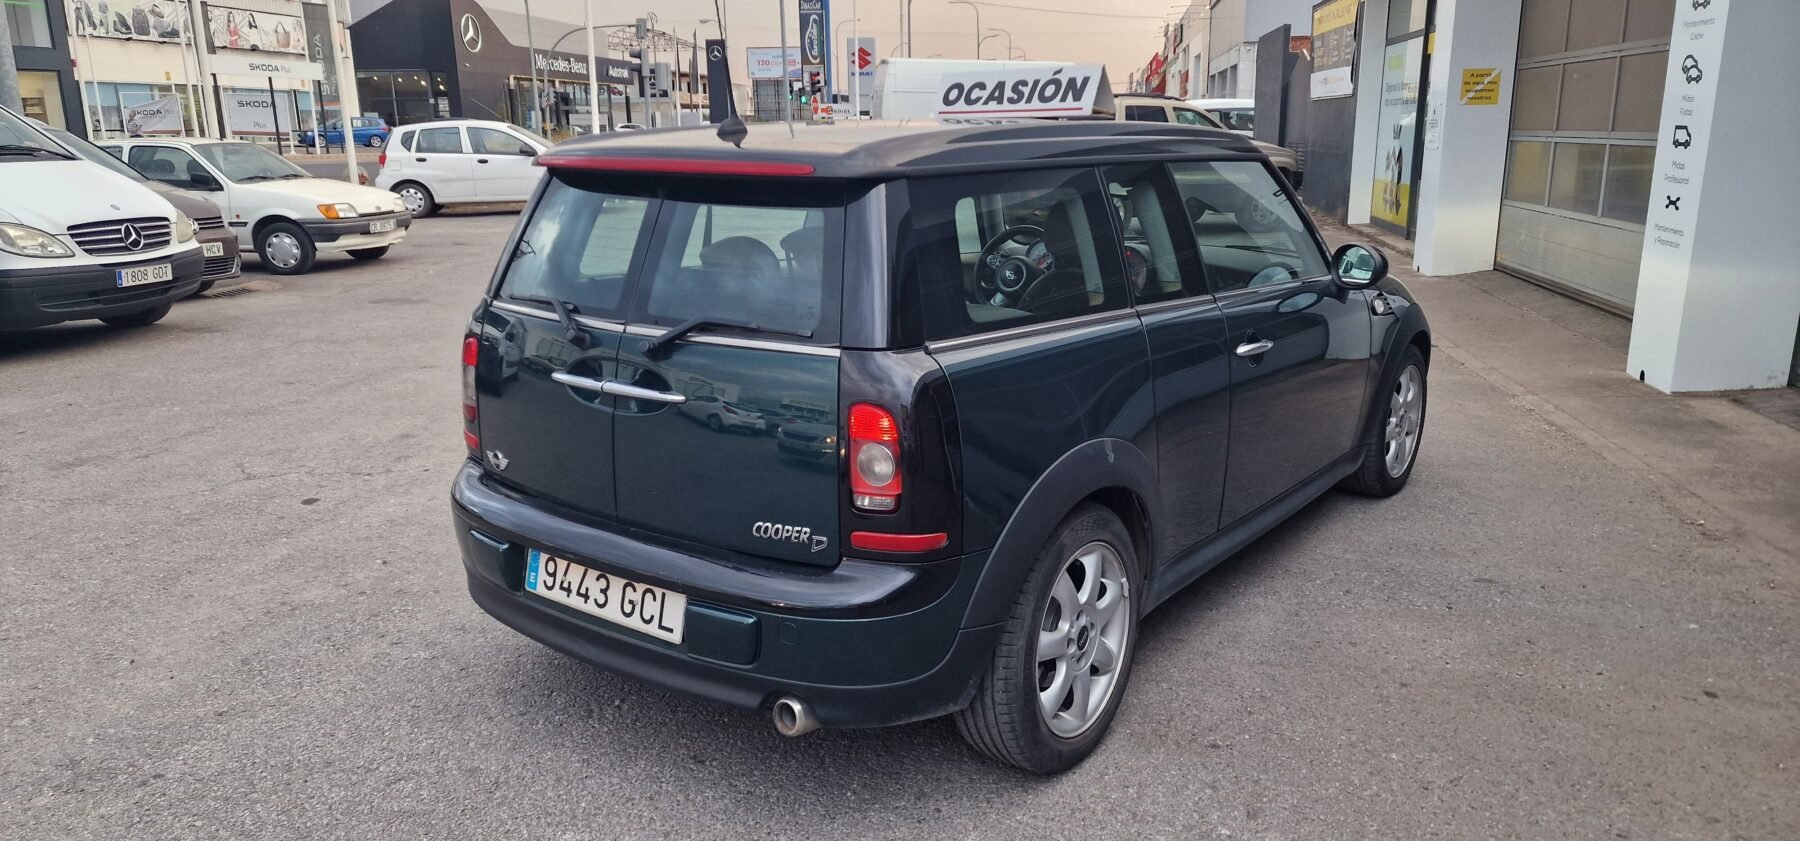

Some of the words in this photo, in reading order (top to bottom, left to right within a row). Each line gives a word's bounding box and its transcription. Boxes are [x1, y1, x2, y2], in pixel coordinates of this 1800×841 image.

[535, 54, 588, 74] Mercedes-Benz
[942, 68, 1091, 106] OCASIÓN
[253, 121, 268, 129] Plus
[1672, 161, 1685, 170] Midas
[206, 244, 221, 255] HCV
[125, 269, 149, 284] 1808
[152, 266, 169, 280] GDT
[752, 521, 811, 544] COOPER
[543, 556, 610, 609] 9443
[620, 581, 674, 634] GCL
